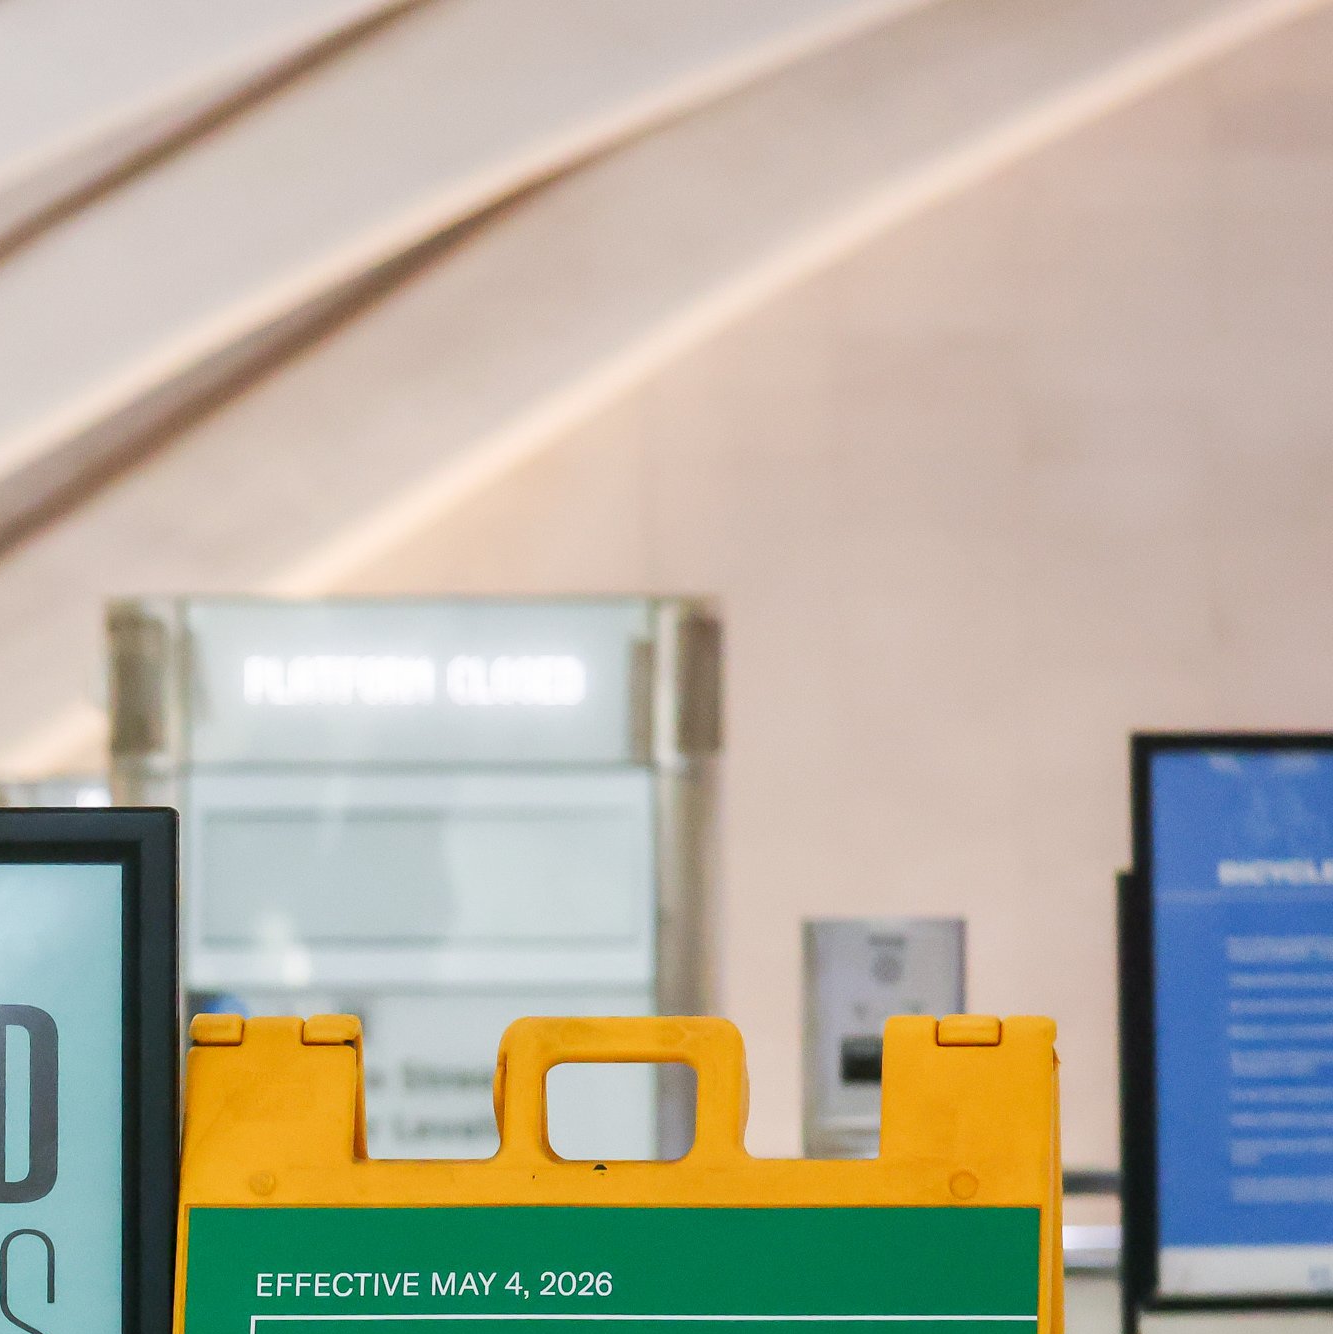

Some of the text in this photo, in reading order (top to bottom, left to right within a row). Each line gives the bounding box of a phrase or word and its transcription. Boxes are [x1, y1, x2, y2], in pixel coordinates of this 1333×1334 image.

[257, 1272, 612, 1299] EFFECTIVE MAY 4, 2026
